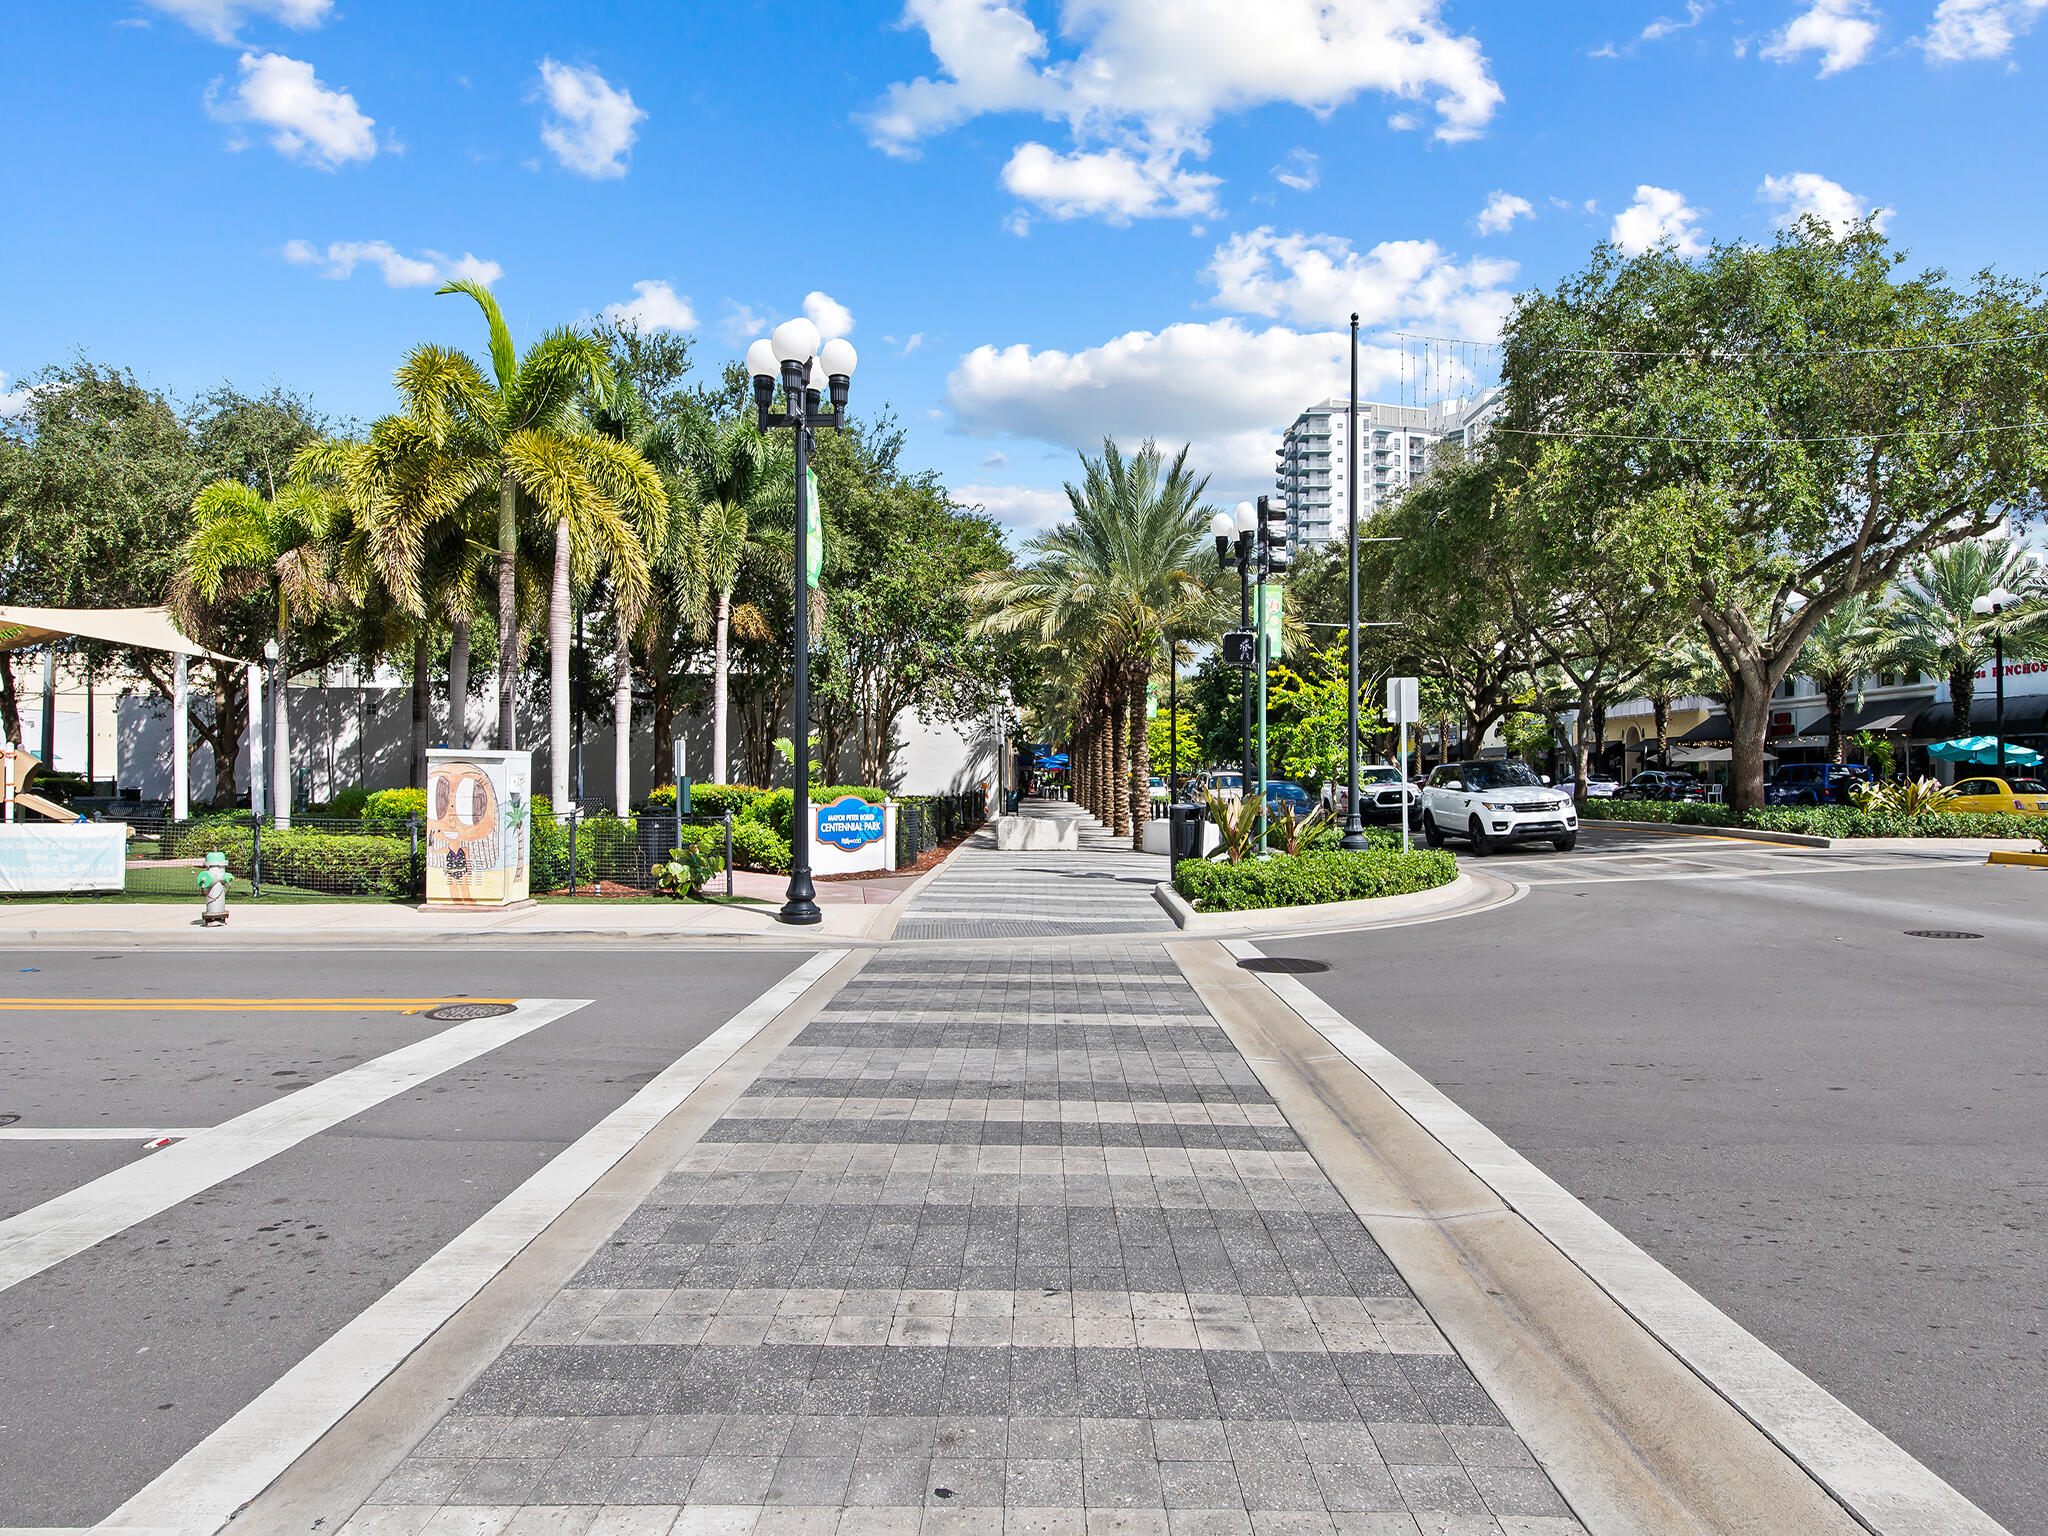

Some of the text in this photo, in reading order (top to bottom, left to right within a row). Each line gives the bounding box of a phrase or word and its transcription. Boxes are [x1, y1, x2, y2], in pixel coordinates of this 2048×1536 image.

[1992, 663, 2048, 678] PNCHOS
[821, 821, 881, 832] CENTENNIAL PARK
